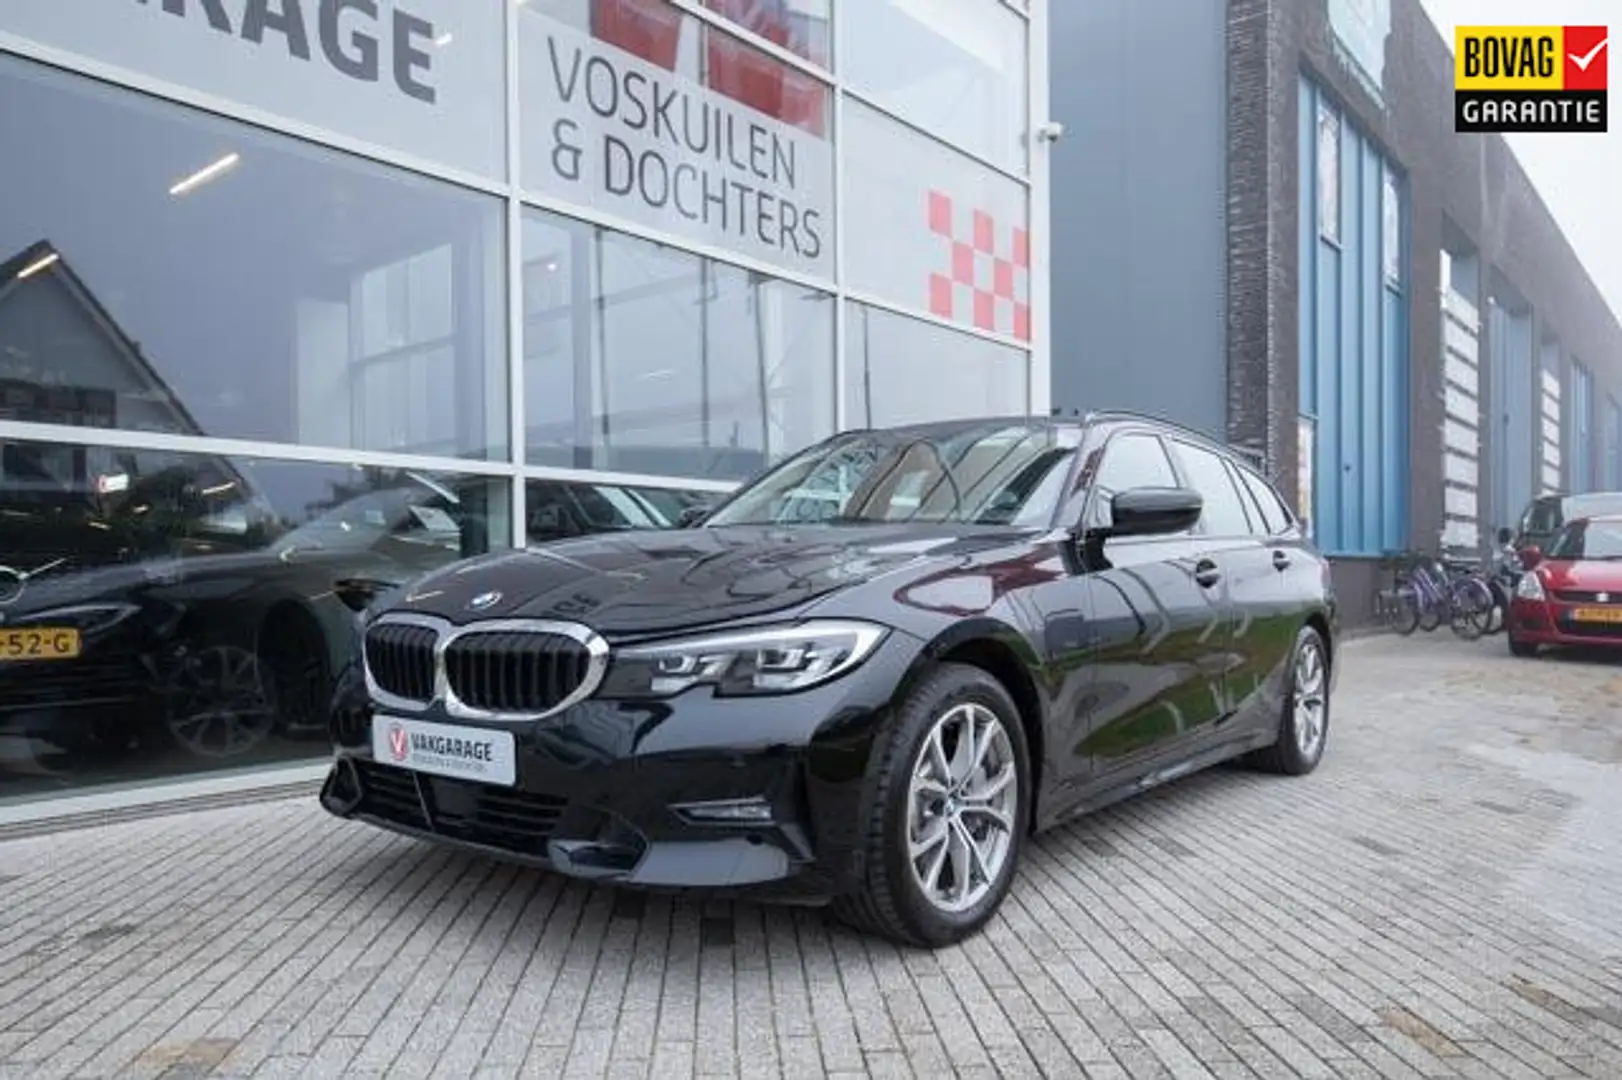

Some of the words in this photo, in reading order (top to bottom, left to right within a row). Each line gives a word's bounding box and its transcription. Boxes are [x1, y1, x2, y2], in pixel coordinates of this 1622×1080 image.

[152, 0, 437, 105] AGE
[547, 35, 796, 190] VOSKUILEN
[551, 117, 583, 181] &
[603, 133, 821, 259] DOCHTERS
[410, 732, 493, 762] VAKGARAGE
